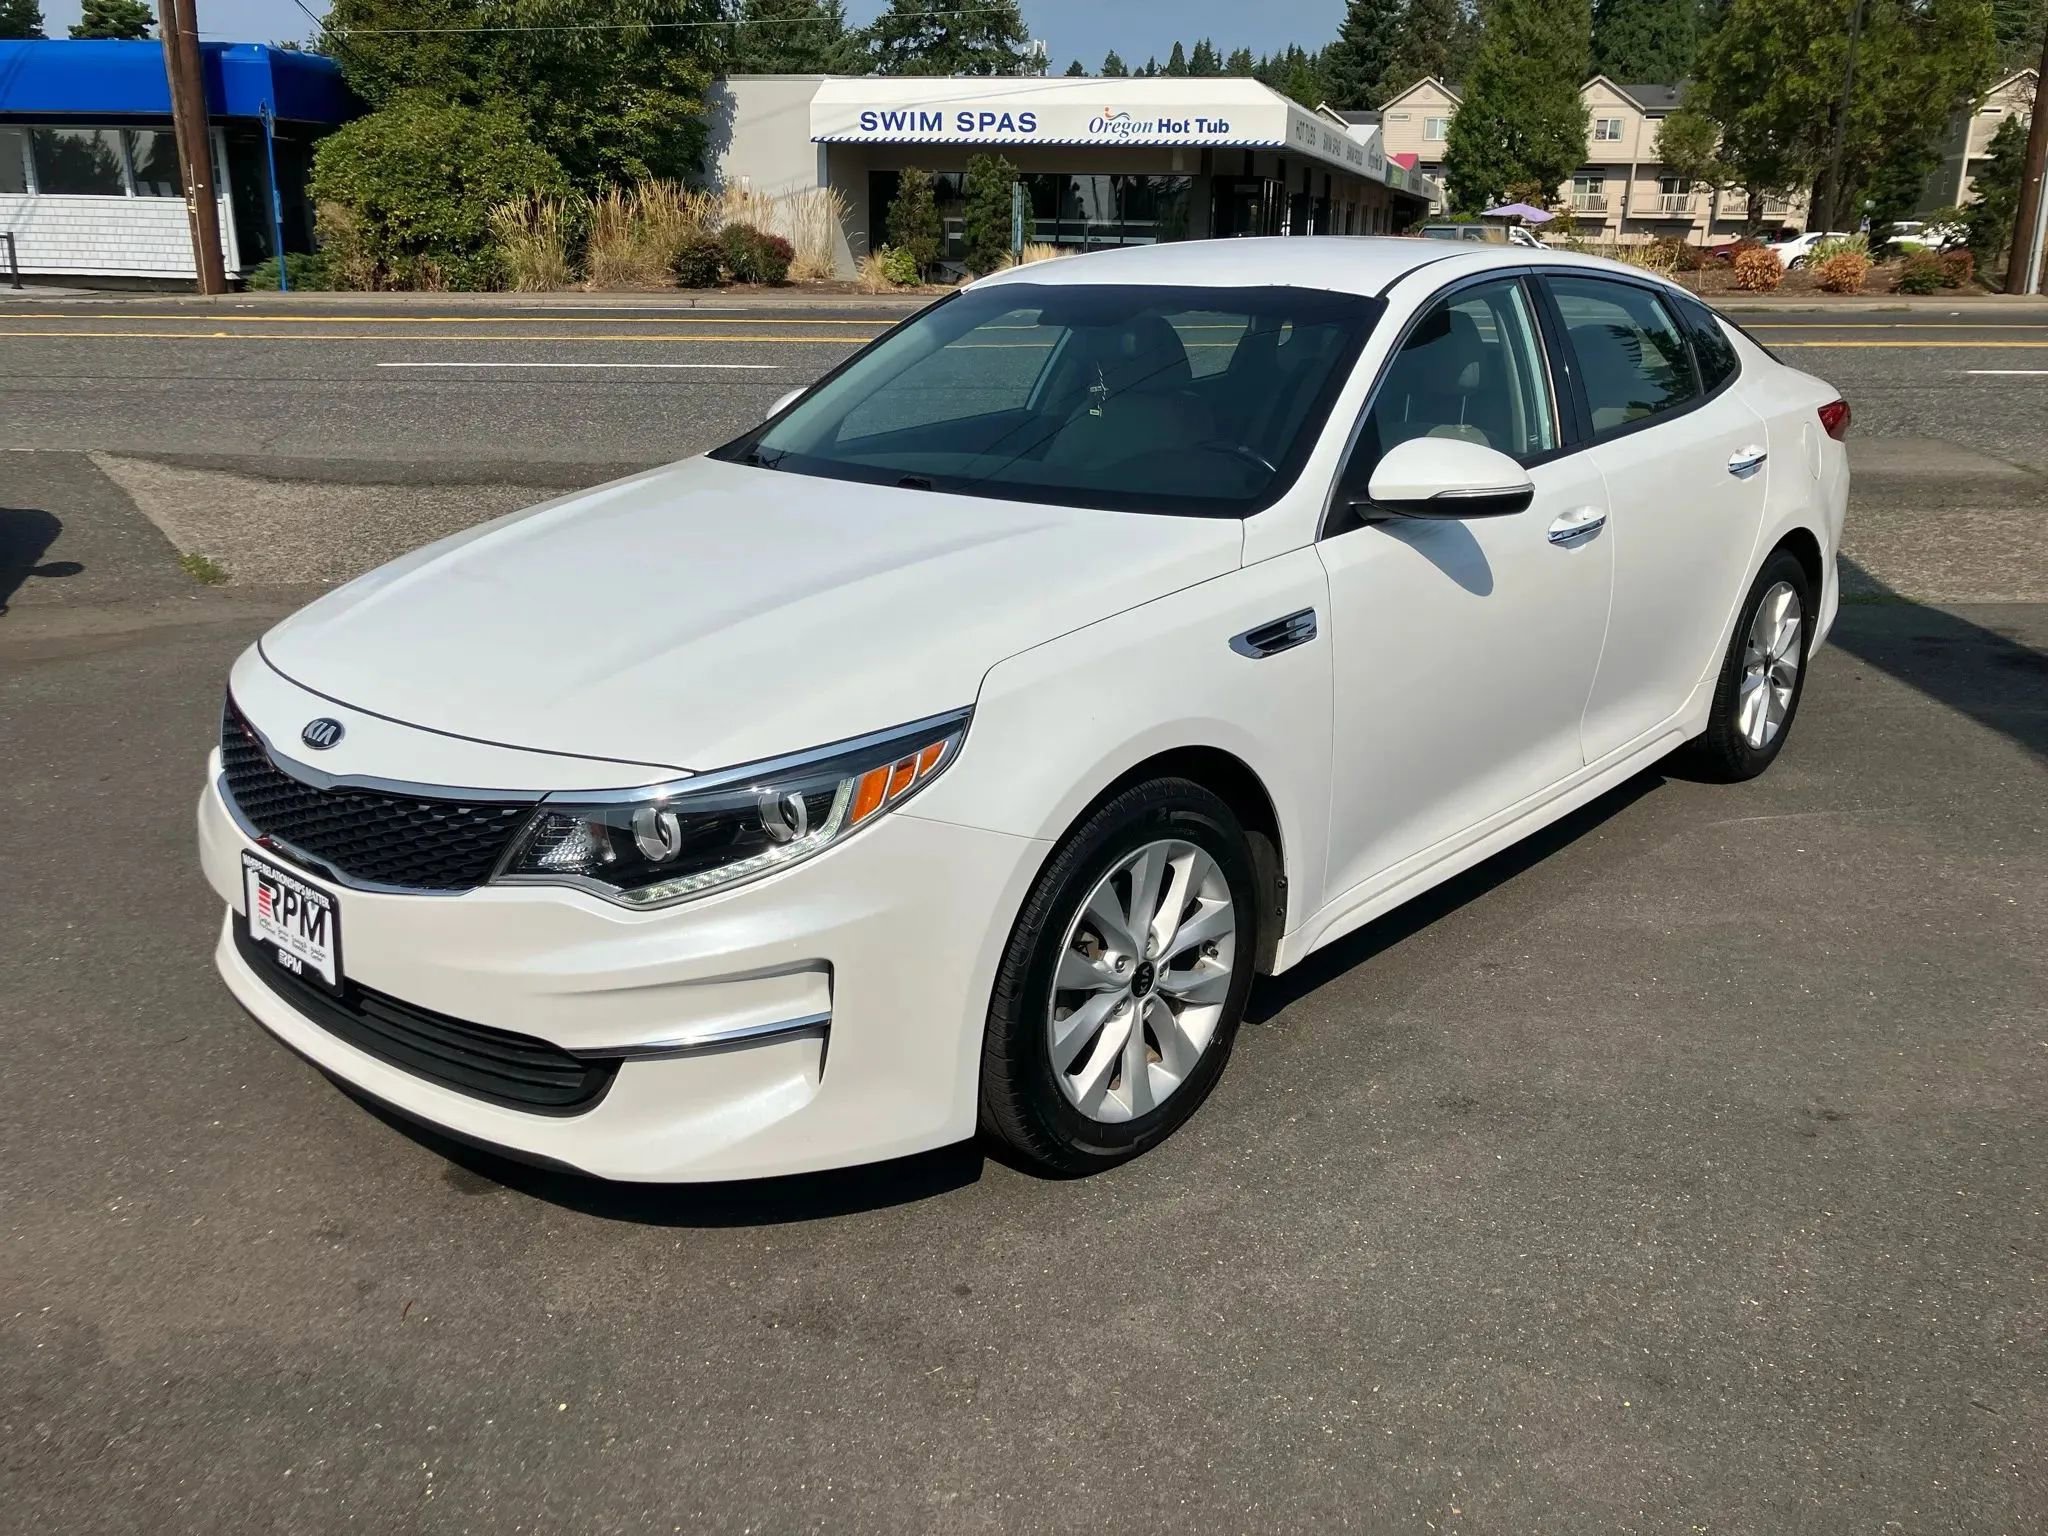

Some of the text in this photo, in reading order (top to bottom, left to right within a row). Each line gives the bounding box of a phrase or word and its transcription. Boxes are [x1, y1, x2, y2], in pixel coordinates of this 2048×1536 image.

[860, 111, 1037, 133] SWIM SPAS
[1089, 117, 1229, 138] Oregon Hot Tub
[303, 720, 337, 745] KIA
[258, 871, 327, 948] RPM
[279, 948, 303, 975] RPM
